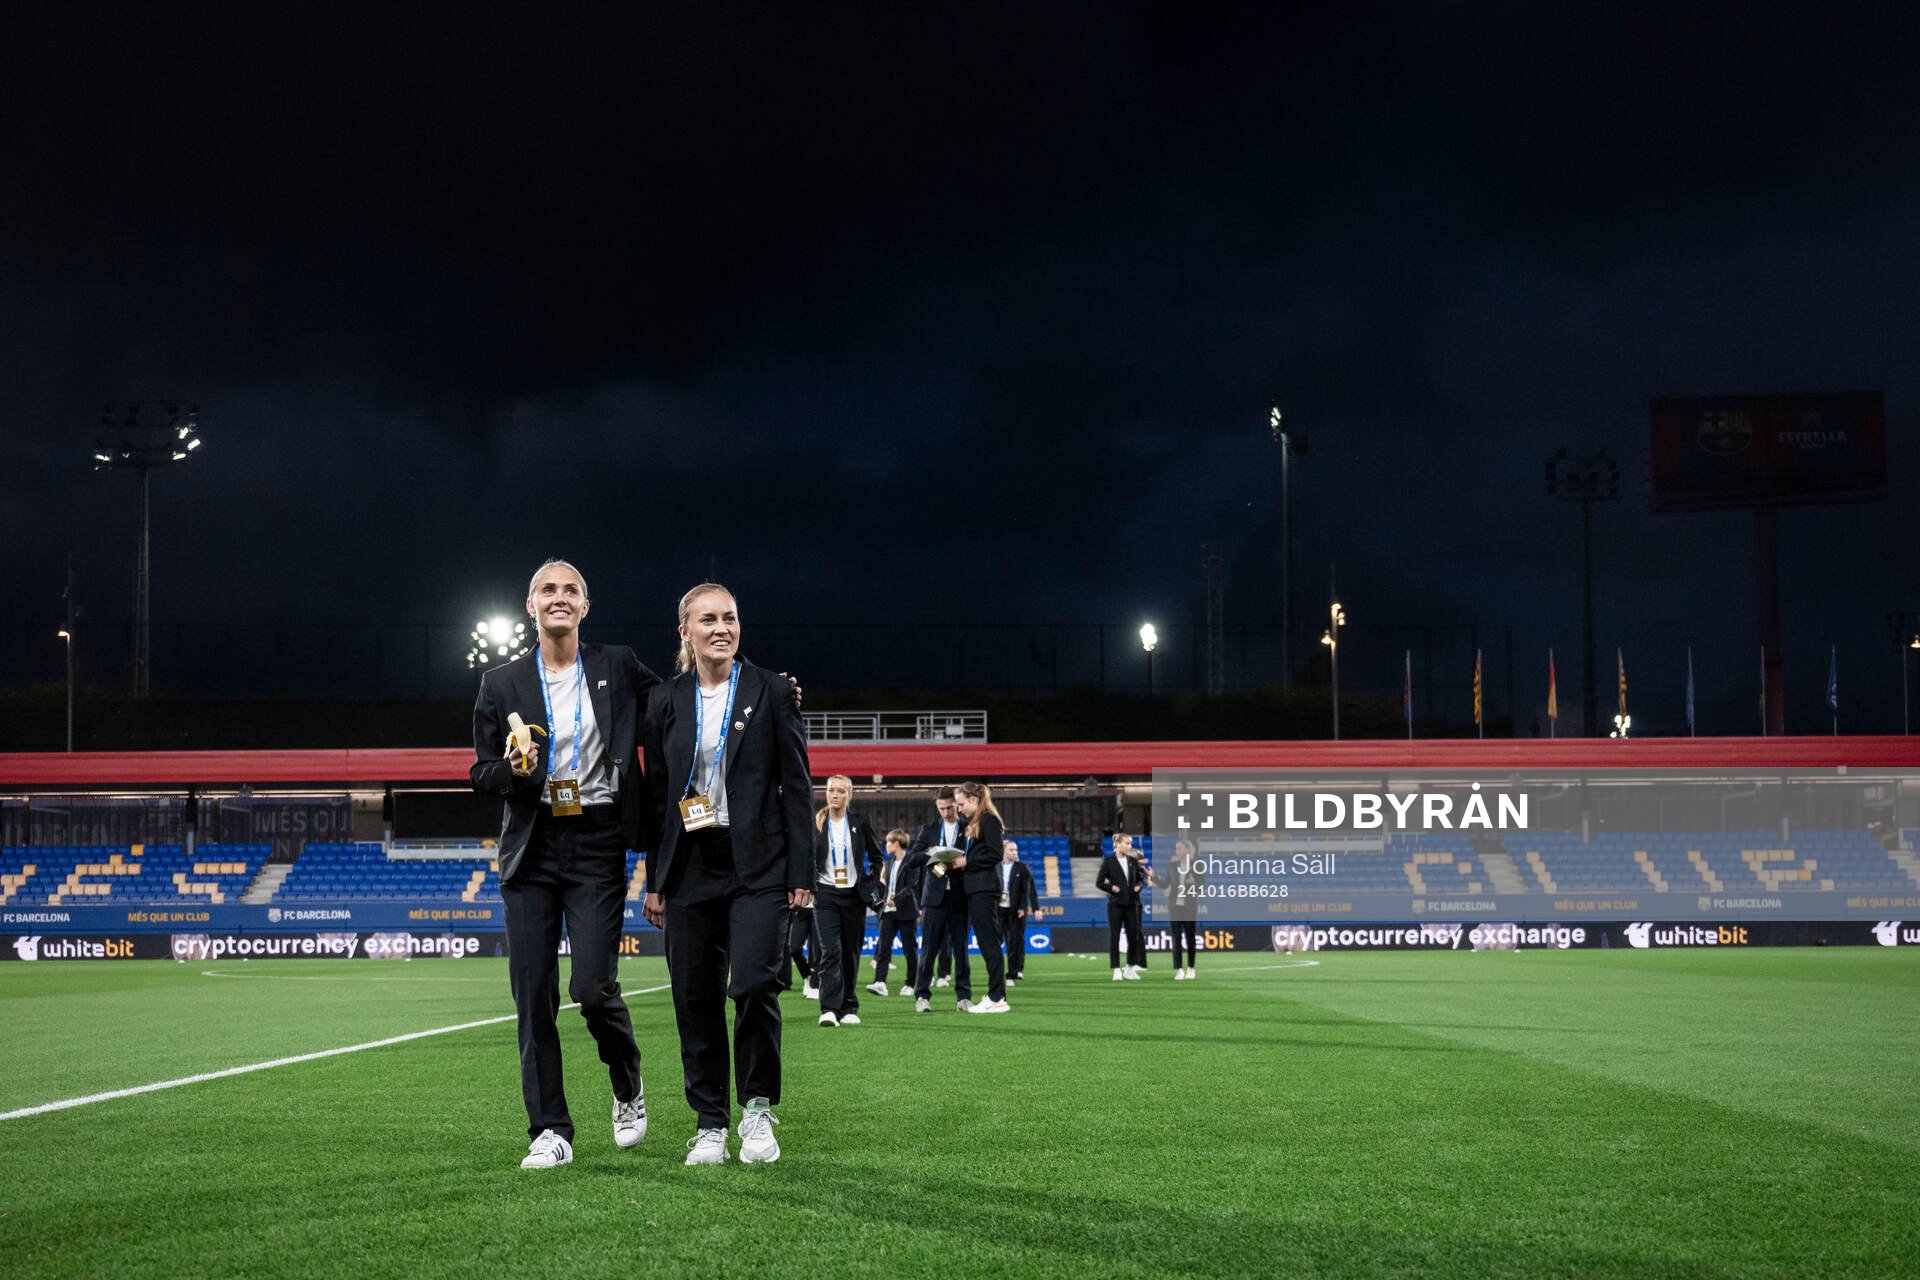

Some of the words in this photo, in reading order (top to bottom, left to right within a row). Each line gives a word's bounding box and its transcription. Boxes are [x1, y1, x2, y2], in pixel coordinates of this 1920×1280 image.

[1779, 431, 1846, 443] ESTRELLA
[255, 806, 308, 833] MÉS
[1268, 902, 1287, 914] MÉS
[1290, 902, 1310, 914] QUE
[1312, 902, 1326, 913] UN
[1328, 902, 1352, 913] CLUB
[1428, 901, 1440, 912] FC
[1441, 900, 1497, 912] BARCELONA
[1553, 899, 1573, 911] MÉS
[1575, 899, 1596, 911] QUE
[1598, 899, 1612, 911] UN
[1614, 899, 1638, 910] CLUB
[1713, 898, 1725, 909] FC
[1726, 898, 1782, 909] BARCELONA
[1847, 896, 1867, 907] MÉS
[1869, 896, 1889, 908] QUE
[1891, 896, 1904, 907] UN
[3, 913, 16, 923] FC
[16, 912, 71, 923] BARCELONA
[128, 911, 148, 922] MÉS
[149, 911, 168, 923] QUE
[169, 912, 185, 922] UN
[187, 911, 210, 922] CLUB
[284, 911, 296, 920] FC
[297, 910, 352, 920] BARCELONA
[410, 908, 429, 920] MÉS
[431, 909, 450, 920] QUE
[451, 909, 466, 920] UN
[467, 909, 492, 920] CLUB
[1274, 926, 1463, 951] cryptocurrency
[1470, 926, 1586, 949] exchange
[1655, 926, 1748, 945] whitebit
[44, 938, 134, 958] whitebit
[174, 936, 358, 960] cryptocurrency
[364, 934, 480, 960] exchange
